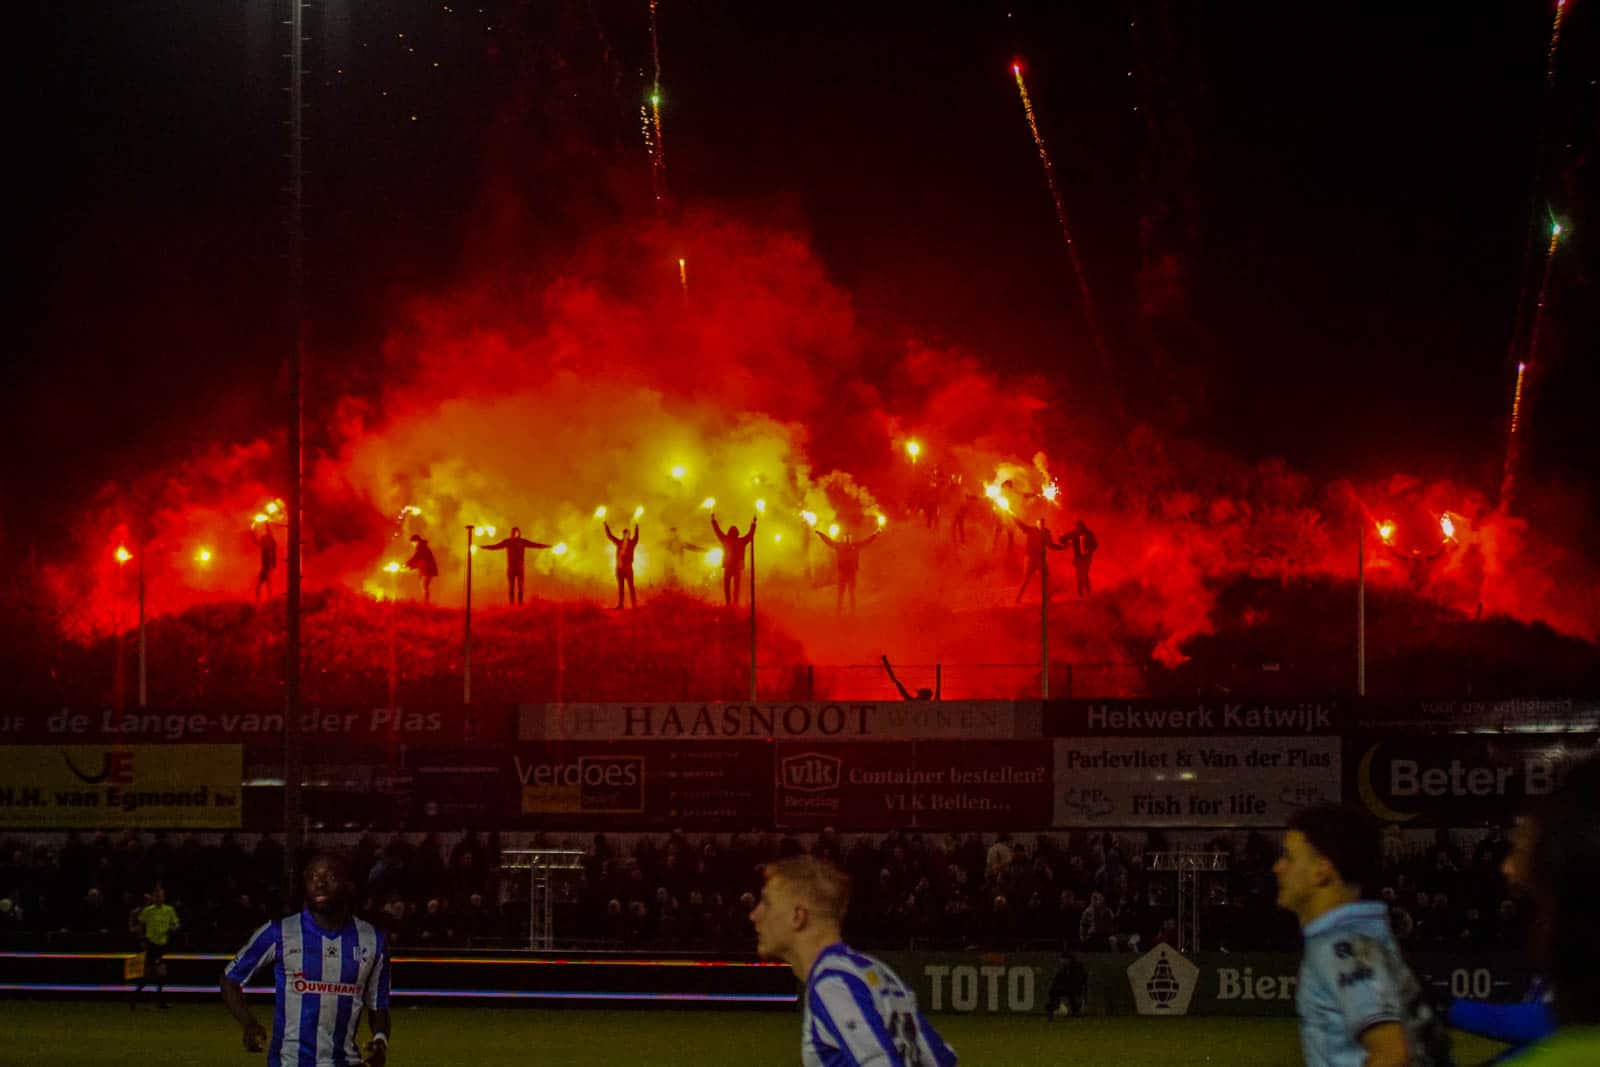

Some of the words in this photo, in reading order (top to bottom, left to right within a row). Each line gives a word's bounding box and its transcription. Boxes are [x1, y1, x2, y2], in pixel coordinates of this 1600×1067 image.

[47, 706, 90, 732] de
[102, 708, 285, 740] Lange-van
[302, 707, 359, 732] der
[369, 707, 441, 732] Plas
[622, 704, 877, 736] HAASNOOT
[1088, 704, 1217, 729] Hekwerk
[1224, 704, 1331, 732] Katwijk
[1068, 750, 1169, 768] Parlevliet
[1176, 751, 1192, 768] &
[1200, 750, 1239, 768] Van
[1247, 750, 1281, 768] der
[1287, 750, 1331, 768] Plas
[849, 767, 946, 784] Container
[951, 766, 1046, 785] bestellen?
[1390, 758, 1514, 797] Beter
[57, 791, 99, 807] van
[107, 785, 209, 811] Egmond
[1133, 795, 1181, 815] Fish
[1188, 795, 1223, 815] for
[1229, 794, 1267, 815] life
[924, 964, 1036, 1011] TOTO
[1215, 967, 1298, 1001] Bier
